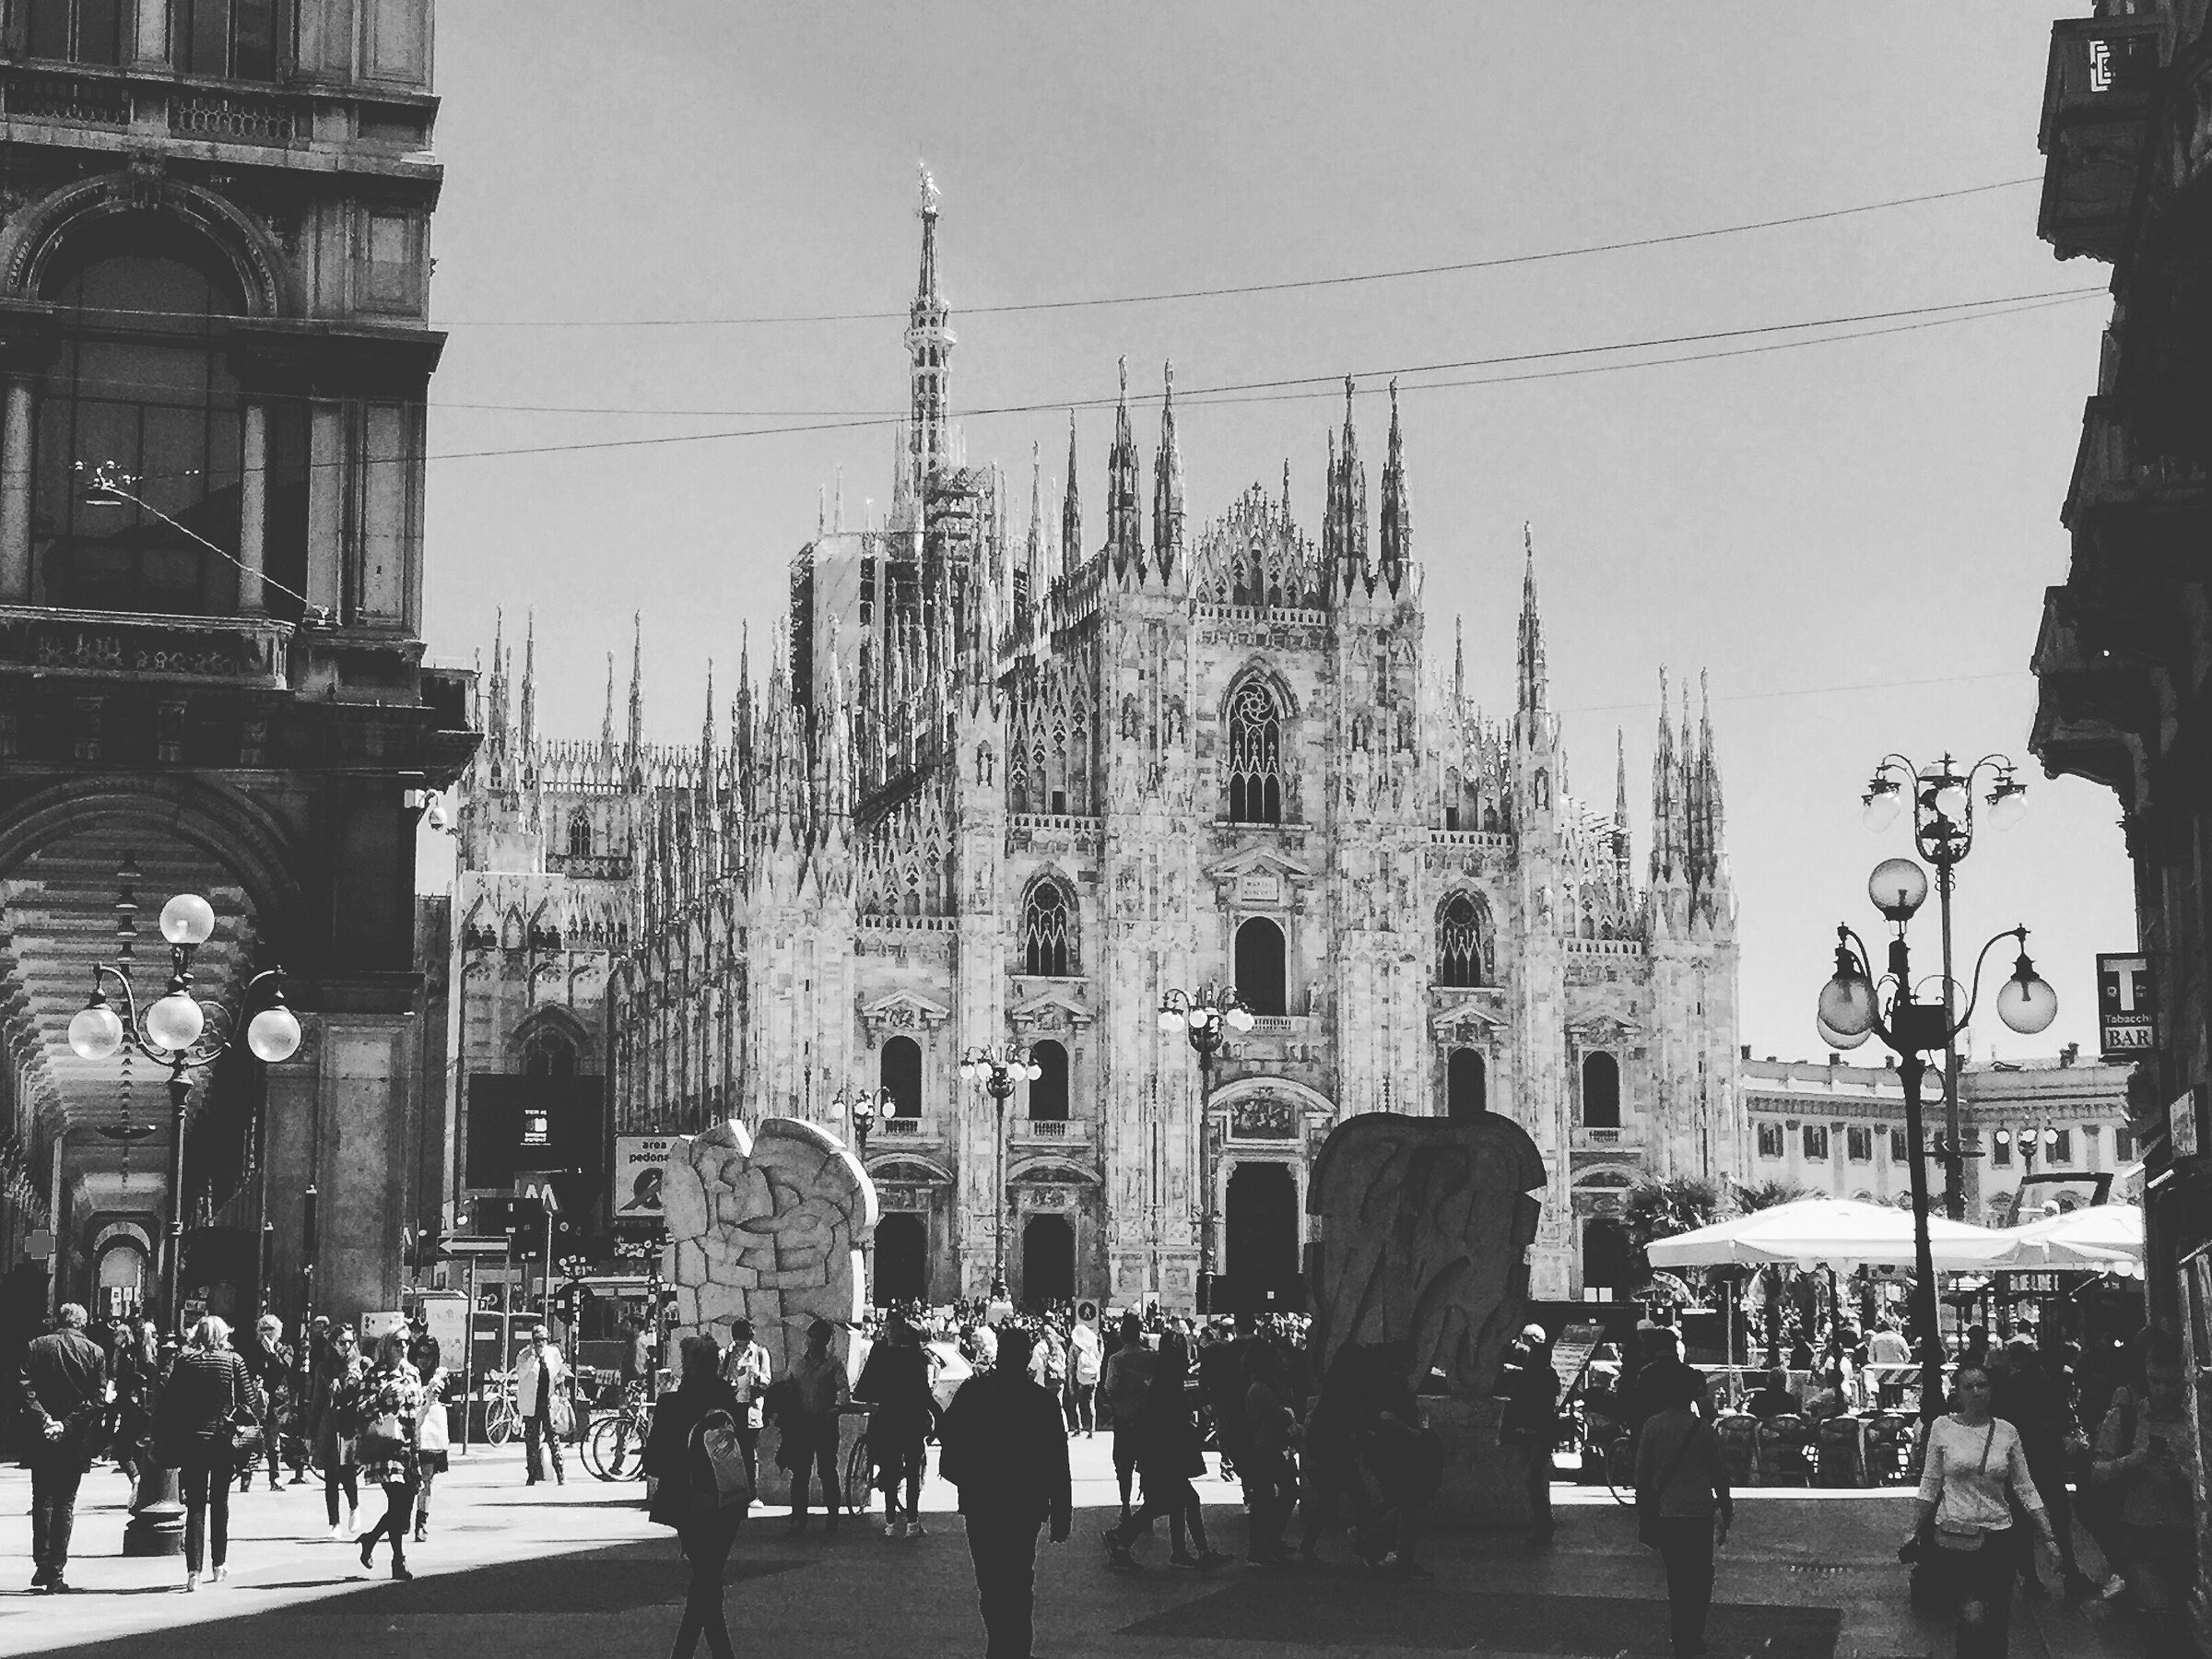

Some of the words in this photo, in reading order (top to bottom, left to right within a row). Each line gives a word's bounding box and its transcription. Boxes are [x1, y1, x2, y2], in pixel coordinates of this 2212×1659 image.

[2103, 959, 2147, 1011] T
[2105, 1014, 2152, 1024] Tabacchi
[2108, 1030, 2151, 1047] BAR
[642, 1141, 666, 1149] area
